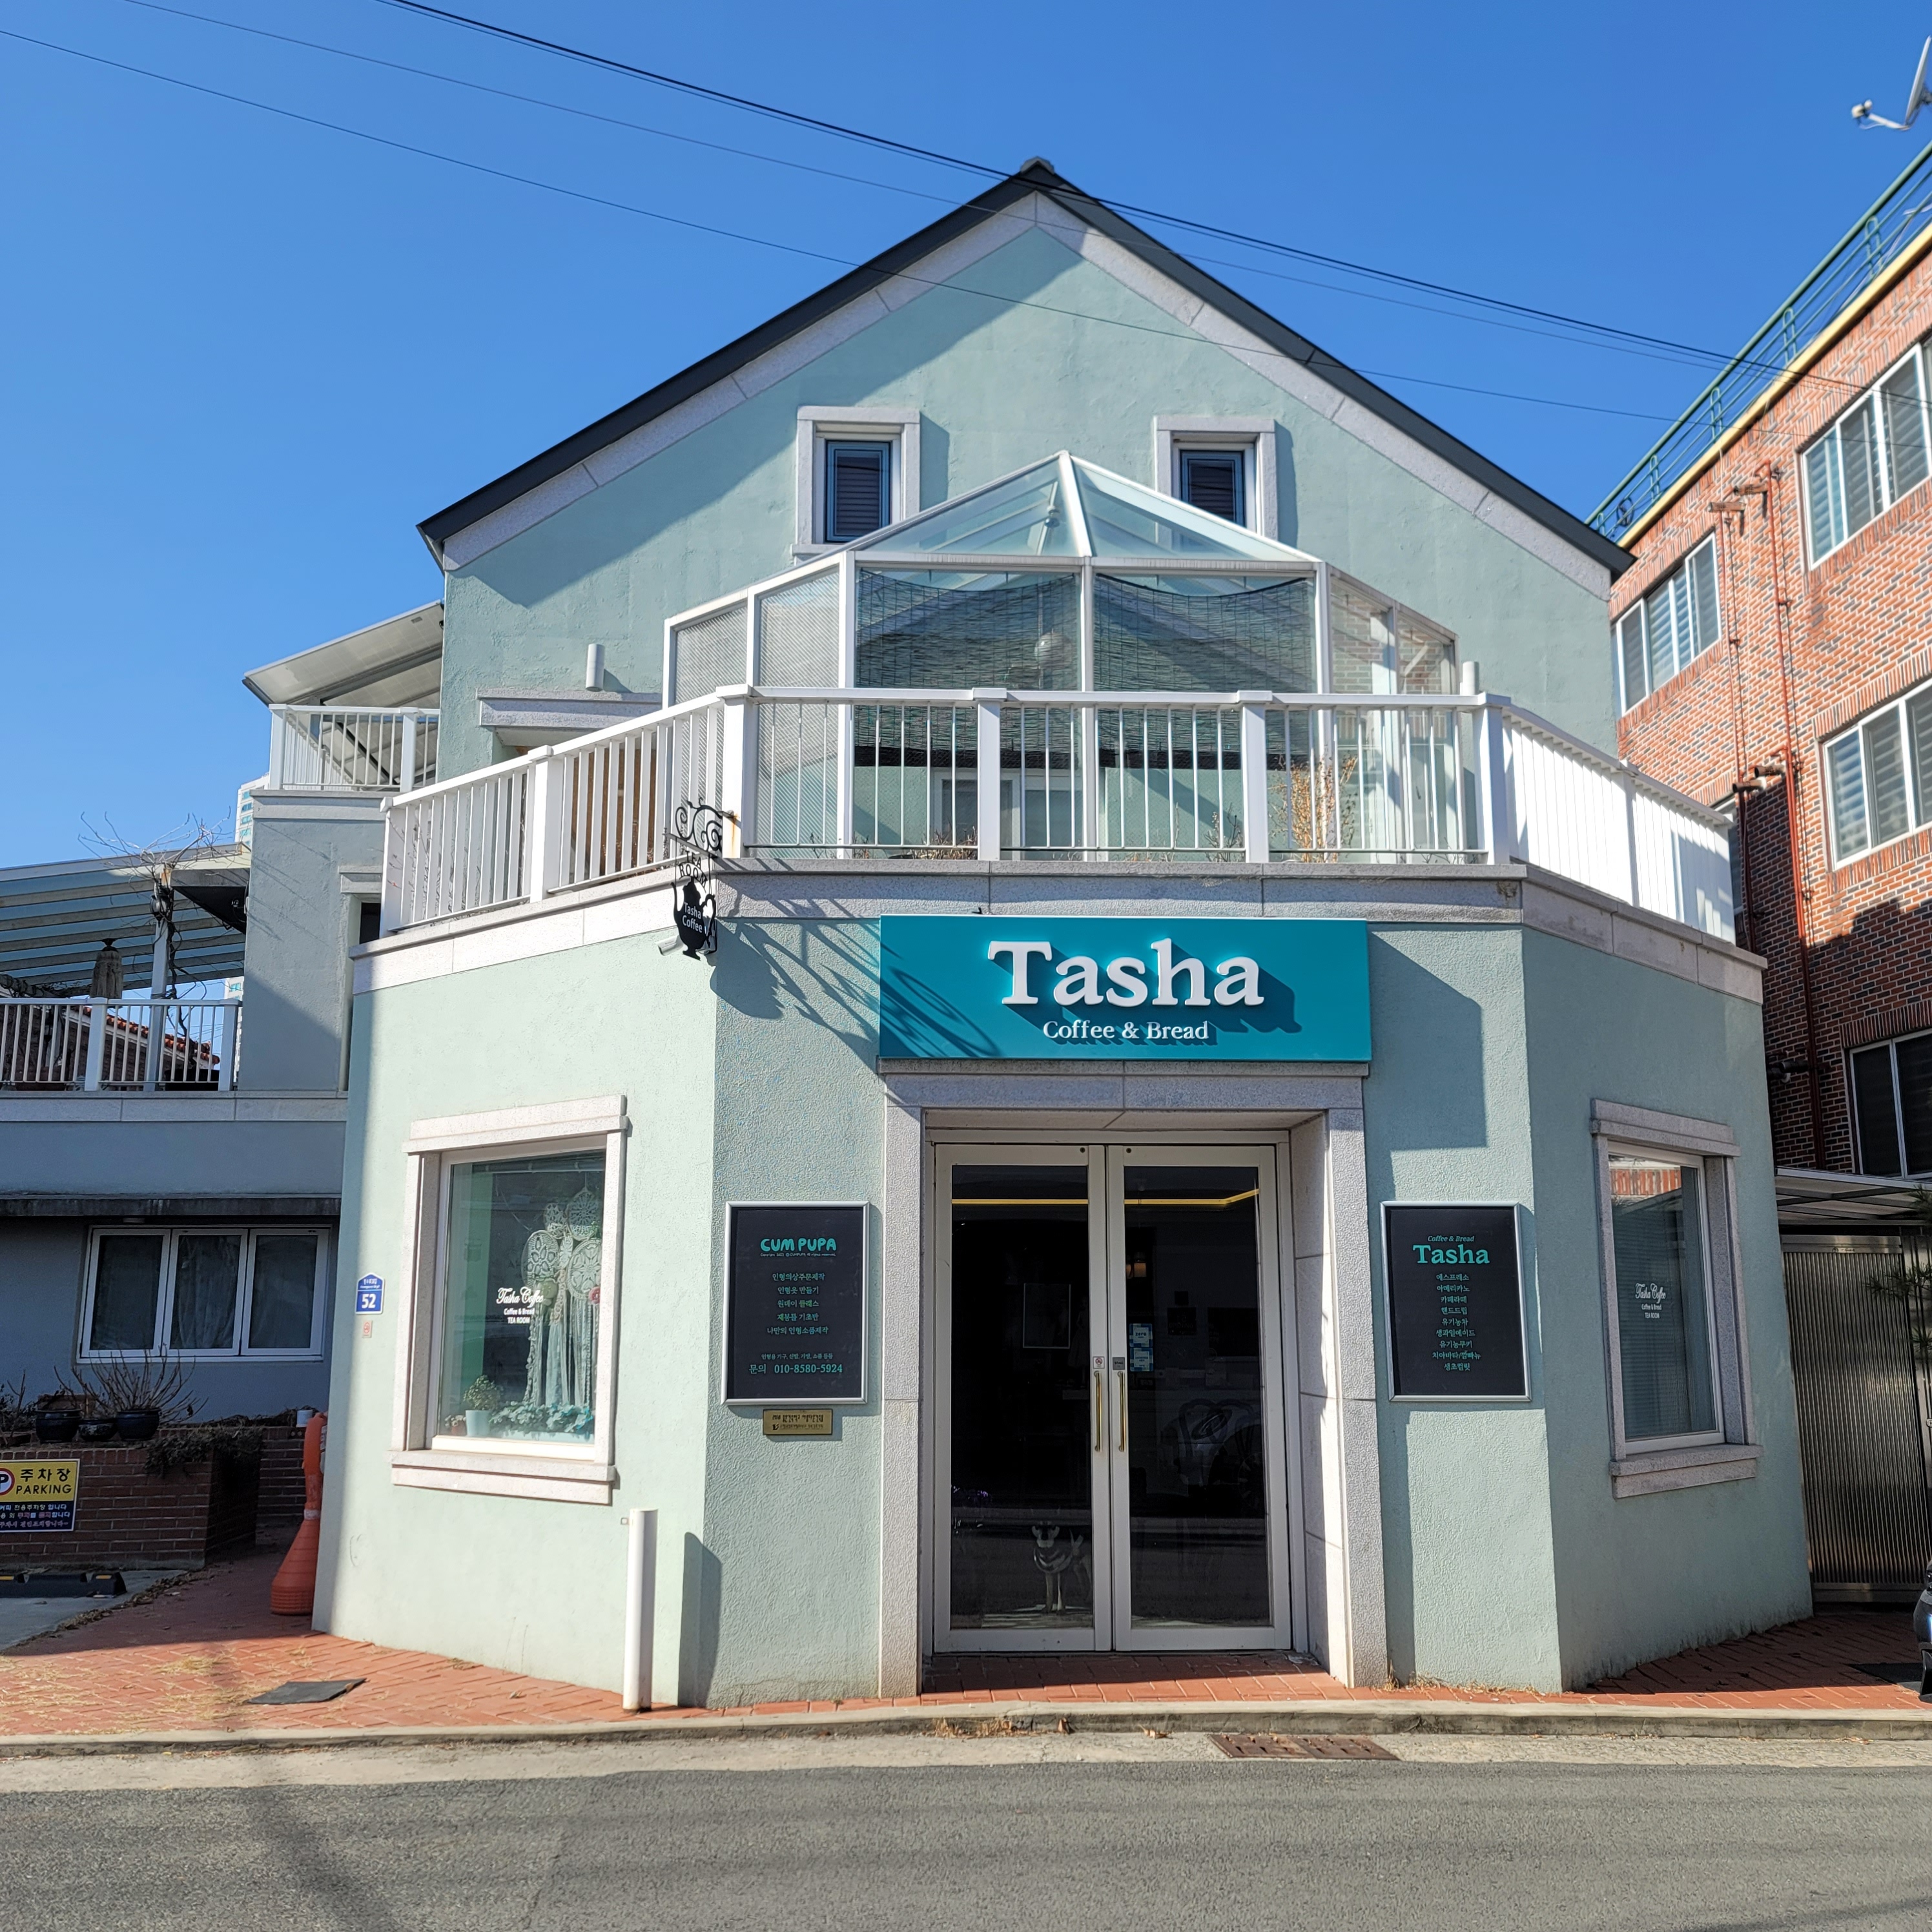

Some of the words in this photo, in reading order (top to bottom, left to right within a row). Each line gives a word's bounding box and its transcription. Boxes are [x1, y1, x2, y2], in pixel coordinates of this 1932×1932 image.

[685, 850, 702, 870] TEA
[679, 863, 708, 888] ROOM
[684, 902, 702, 920] Tasha
[682, 914, 703, 934] Coffee
[987, 938, 1264, 1007] Tasha
[1043, 1020, 1115, 1040] Coffee
[1122, 1022, 1139, 1040] &
[1146, 1020, 1209, 1040] Bread
[760, 1238, 795, 1251] CUM
[797, 1238, 836, 1251] PUPA
[1412, 1244, 1490, 1264] Tasha
[772, 1273, 825, 1281] 인형의상주문제작
[496, 1287, 520, 1304] Tasha
[520, 1286, 544, 1308] Coffee
[777, 1286, 798, 1295] 인형옷
[799, 1286, 819, 1295] 만들기
[1635, 1282, 1651, 1299] Tasha
[1650, 1283, 1666, 1304] Coffee
[362, 1293, 376, 1309] 52
[777, 1299, 797, 1308] 원데이
[799, 1299, 819, 1308] 클래스
[1441, 1295, 1467, 1304] 카페라떼
[777, 1313, 797, 1322] 재봉틀
[799, 1313, 819, 1321] 기초반
[1442, 1318, 1468, 1326] 유기농차
[767, 1326, 787, 1335] 나만의
[788, 1326, 828, 1335] 인형소품제작
[1439, 1340, 1472, 1348] 유기농쿠키
[749, 1364, 766, 1374] 문의
[774, 1364, 843, 1373] 010-8580-5924
[20, 1468, 71, 1482] 주차장
[16, 1485, 72, 1494] PARKING
